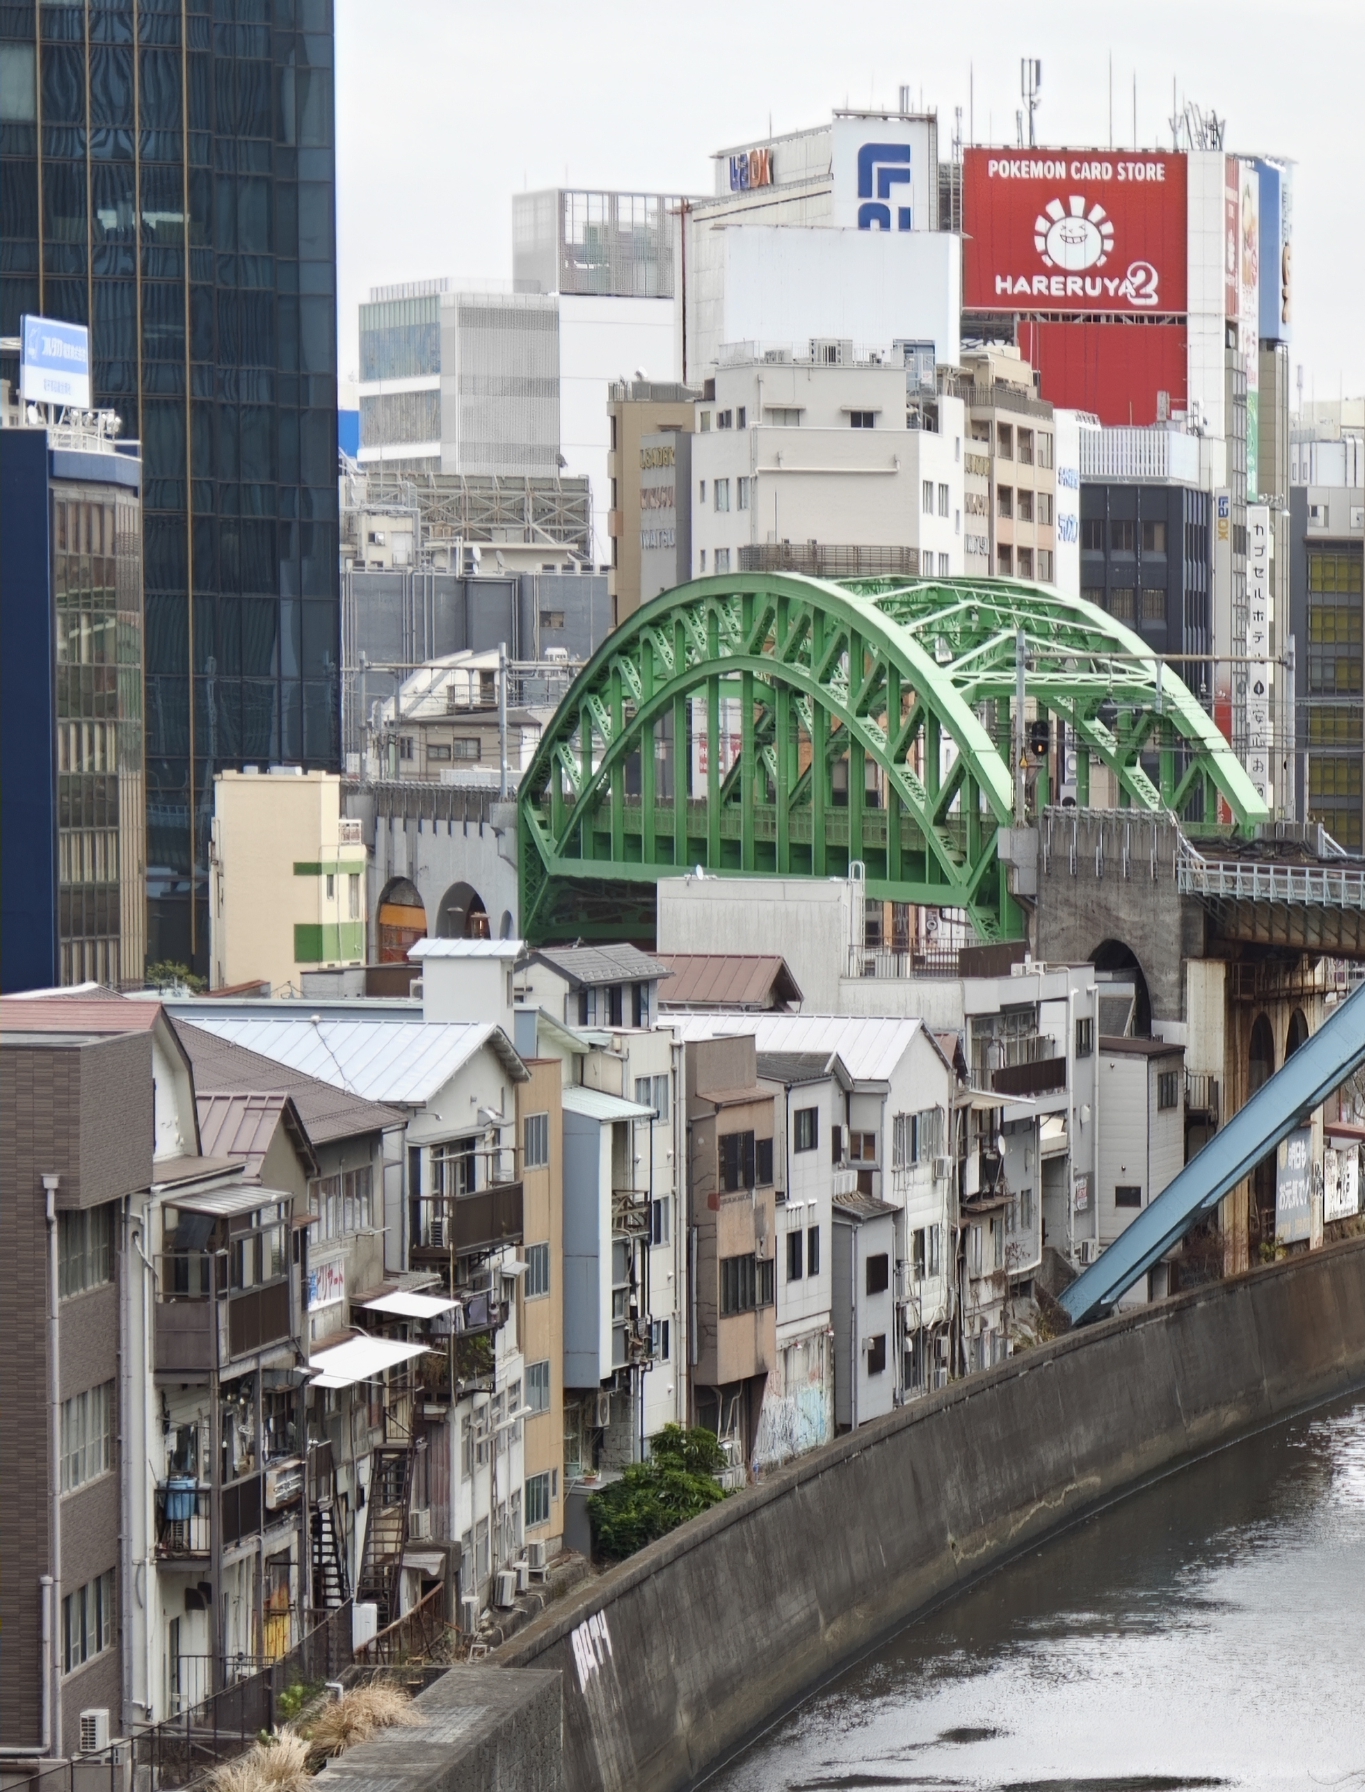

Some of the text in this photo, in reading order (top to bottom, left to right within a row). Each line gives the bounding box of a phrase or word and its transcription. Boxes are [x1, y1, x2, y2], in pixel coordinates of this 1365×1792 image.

[988, 159, 1166, 182] POKEMON CARD STORE
